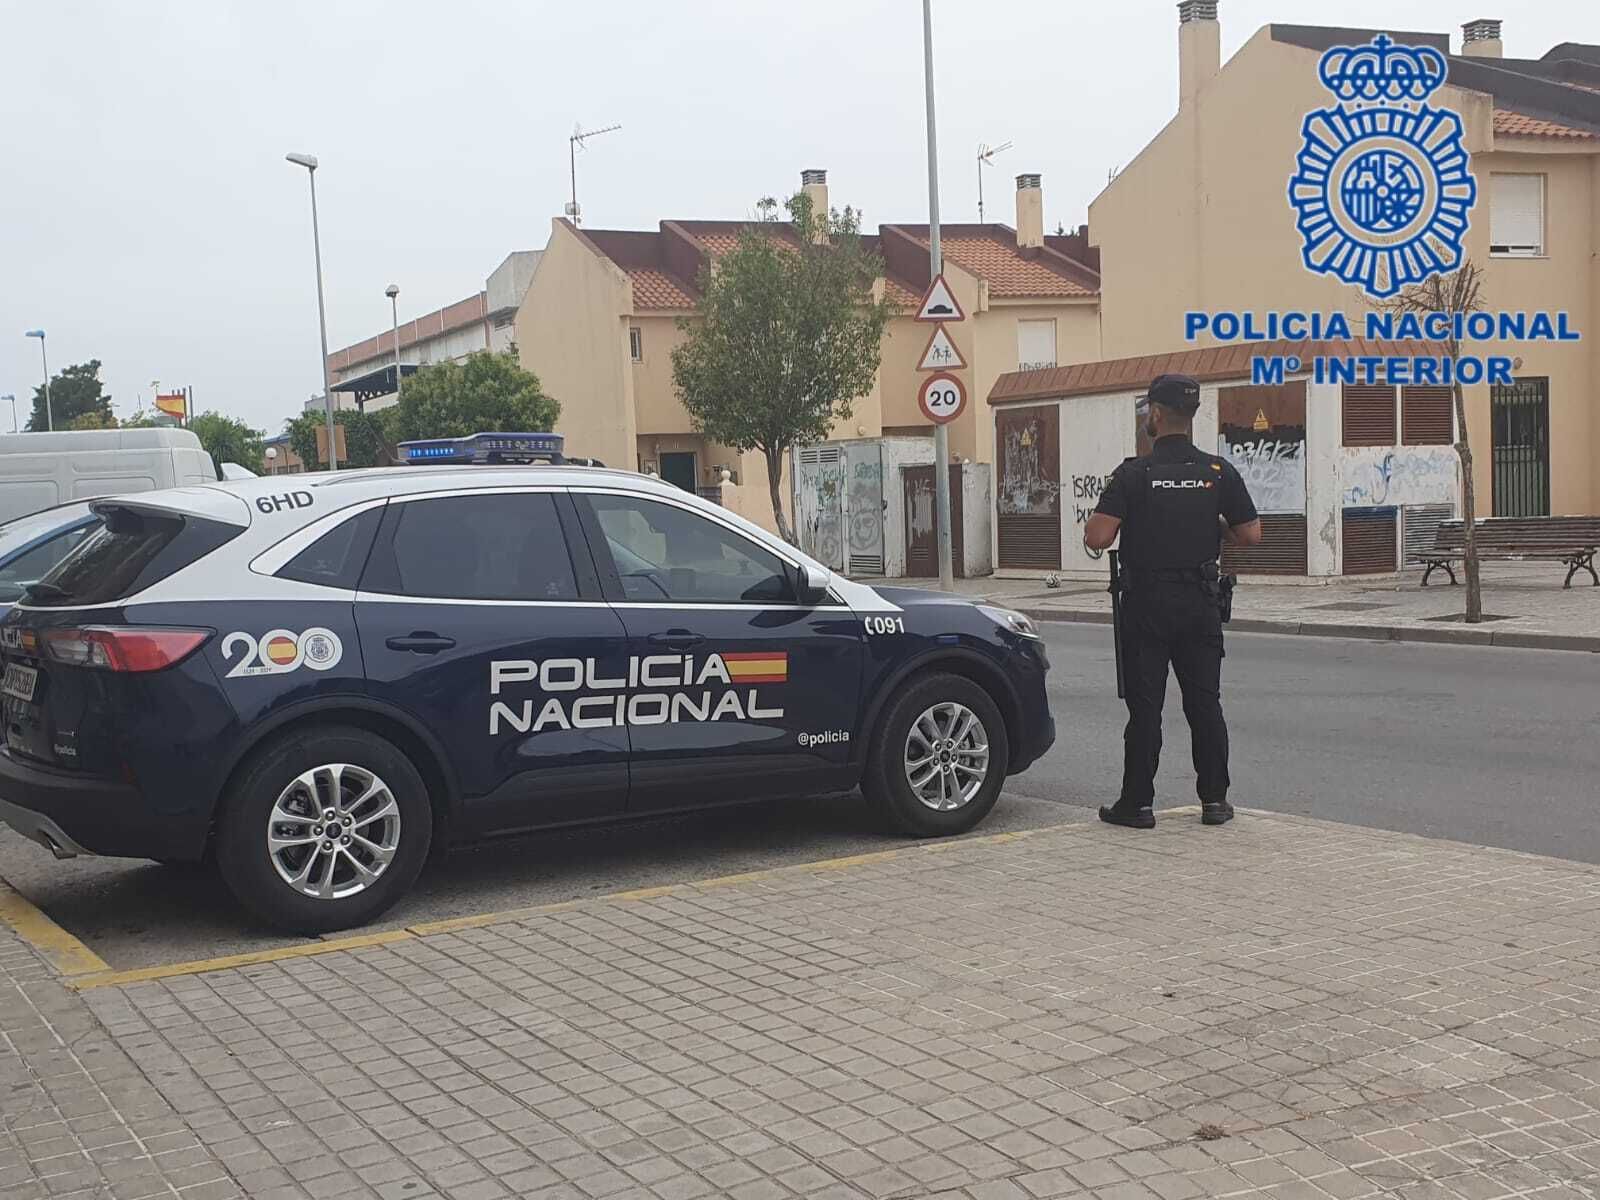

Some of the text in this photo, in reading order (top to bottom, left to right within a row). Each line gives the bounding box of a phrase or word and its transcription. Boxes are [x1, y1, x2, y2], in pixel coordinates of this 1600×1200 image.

[930, 390, 956, 407] 20
[1151, 480, 1205, 489] POLICIA
[255, 490, 314, 514] 6HD
[874, 616, 905, 635] 091
[221, 627, 343, 678] 200
[489, 689, 784, 735] NACIONAL
